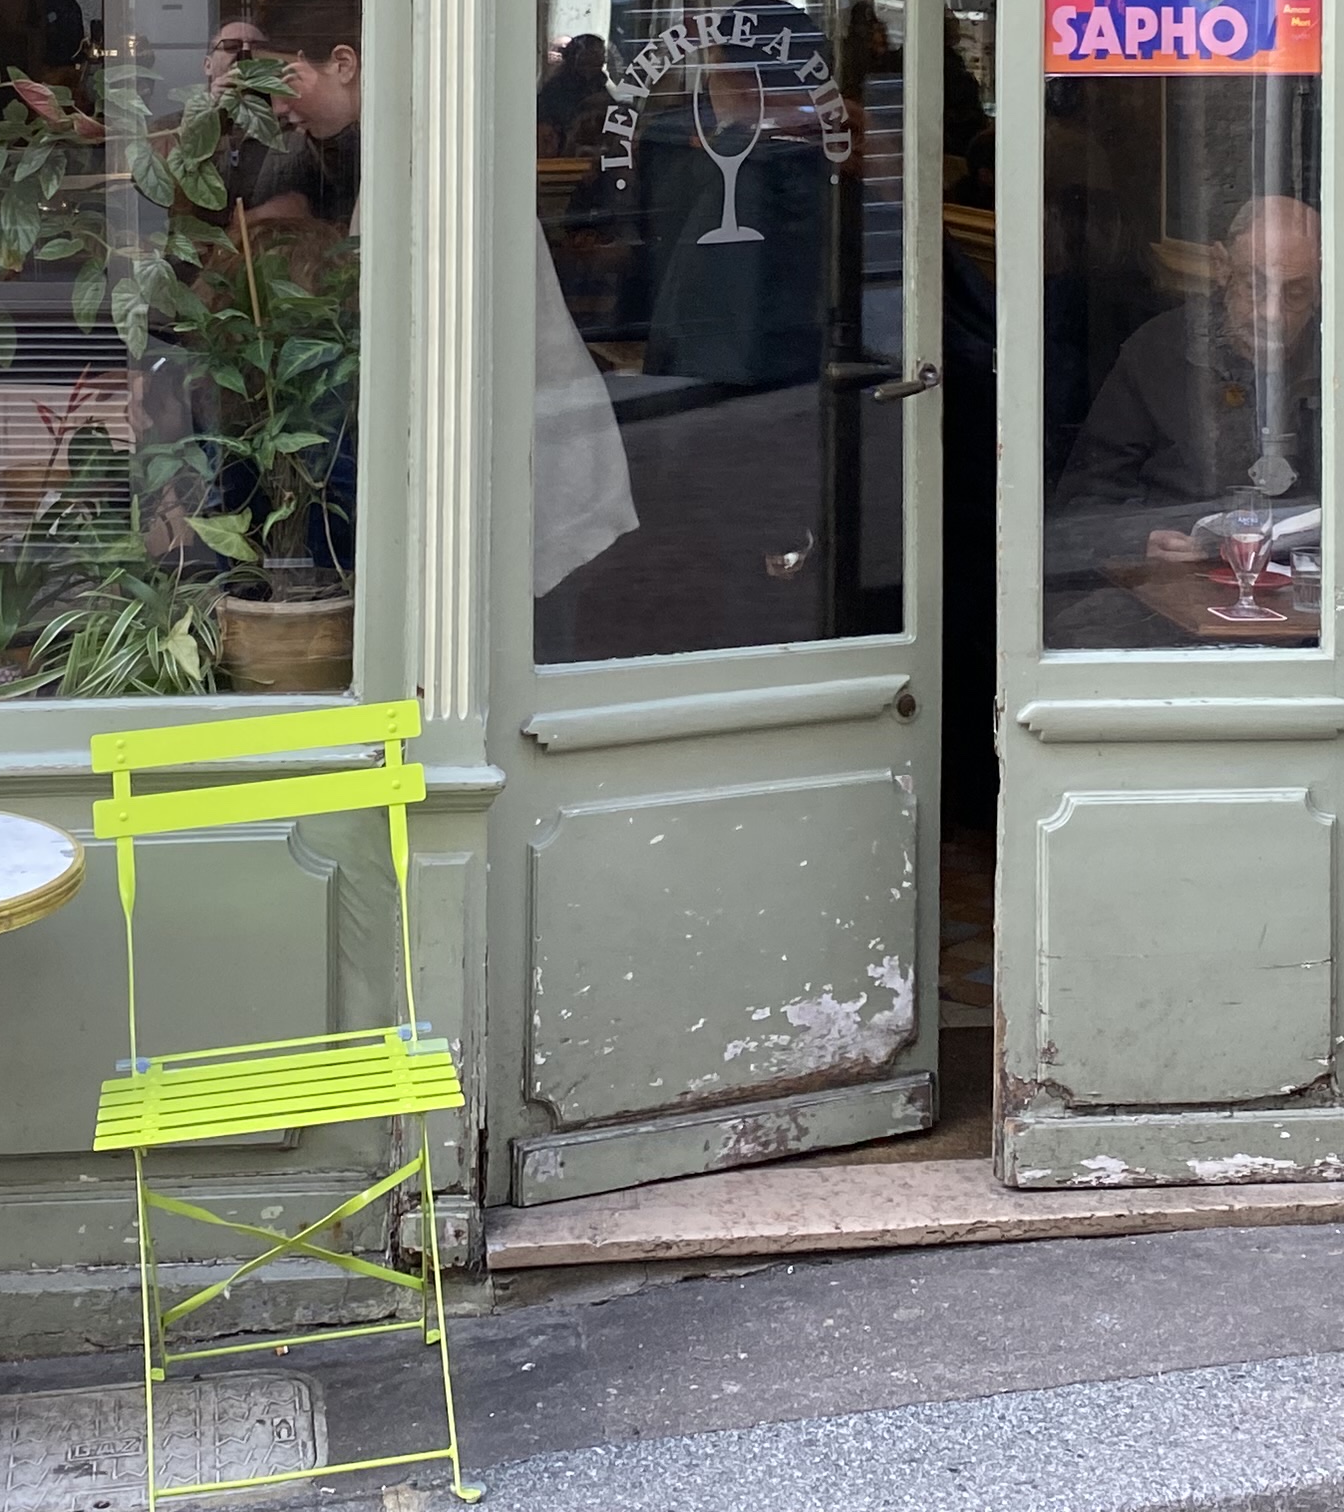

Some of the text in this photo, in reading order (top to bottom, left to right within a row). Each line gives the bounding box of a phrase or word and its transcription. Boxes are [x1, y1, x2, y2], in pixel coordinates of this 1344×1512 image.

[1051, 4, 1249, 56] SAPHO
[600, 9, 853, 172] LE VERRE A PIED
[72, 1437, 143, 1459] GAZ
